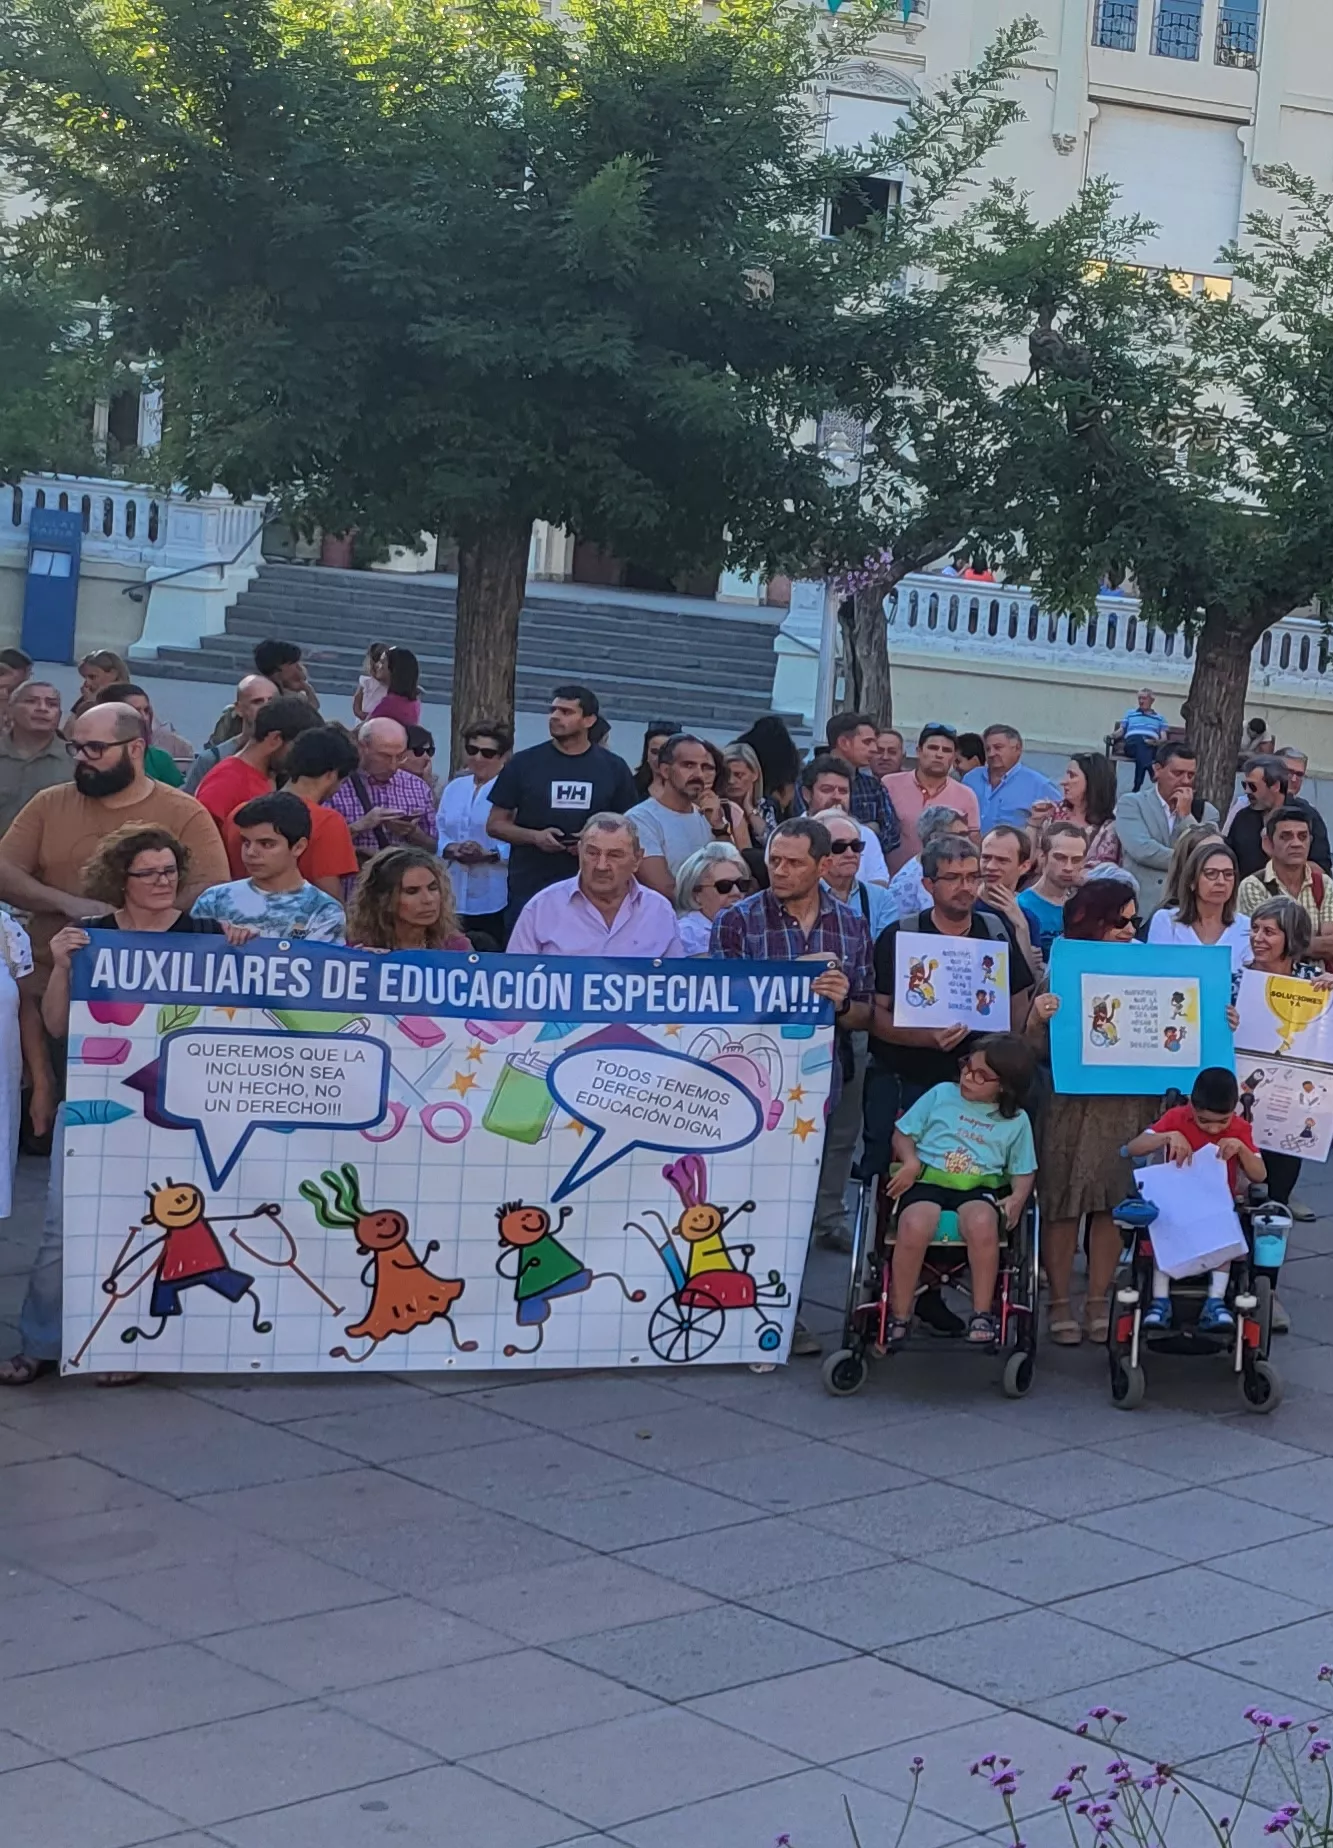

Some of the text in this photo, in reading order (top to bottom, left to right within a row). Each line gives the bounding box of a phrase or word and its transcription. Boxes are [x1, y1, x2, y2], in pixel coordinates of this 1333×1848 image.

[556, 785, 586, 801] HH
[91, 947, 820, 1014] AUXILIARES DE EDUCACIÓN ESPECIAL YA!!!
[1270, 989, 1323, 1005] SOLUCIONES
[187, 1043, 365, 1063] QUEREMOS QUE LA
[205, 1060, 346, 1081] INCLUSIÓN SEA
[207, 1080, 341, 1099] UN HECHO, NO
[595, 1059, 731, 1106] TODOS TENEMOS
[204, 1099, 342, 1117] UN DERECHO!!!
[591, 1076, 720, 1122] DERECHO A UNA
[576, 1091, 723, 1141] EDUCACIÓN DIGNA
